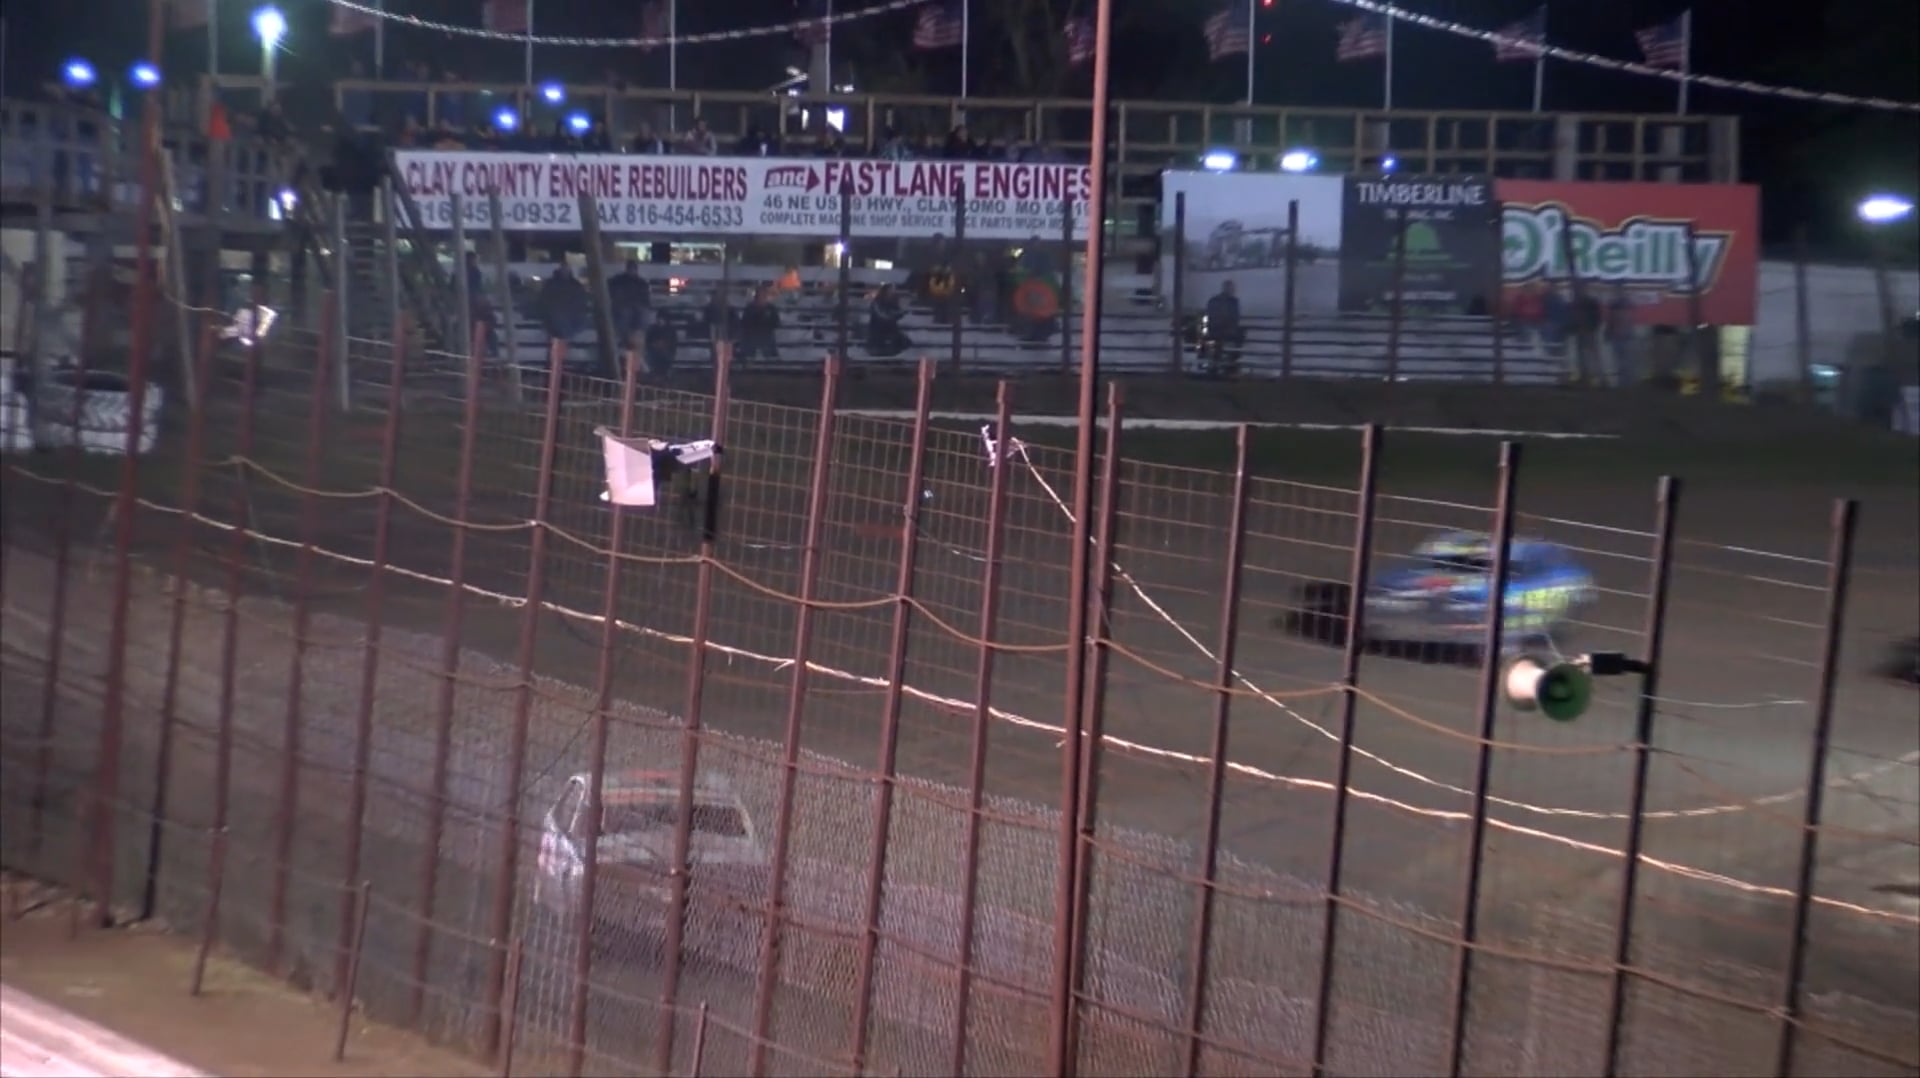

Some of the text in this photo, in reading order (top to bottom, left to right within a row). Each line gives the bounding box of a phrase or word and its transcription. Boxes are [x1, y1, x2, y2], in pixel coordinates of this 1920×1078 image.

[406, 160, 748, 202] CLAY COUNTY ENGINE REBUILDERS
[825, 161, 964, 198] FASTLANE
[974, 165, 1091, 201] ENGINES
[763, 194, 783, 210] 46
[788, 195, 810, 212] NE
[815, 196, 839, 212] US
[1015, 200, 1042, 217] MO
[1357, 182, 1486, 206] TIMBERLINE
[625, 204, 744, 225] 816-454-6533
[760, 211, 818, 226] COMPLETE
[901, 214, 945, 229] SERVICE
[1502, 209, 1718, 292] O'Reilly
